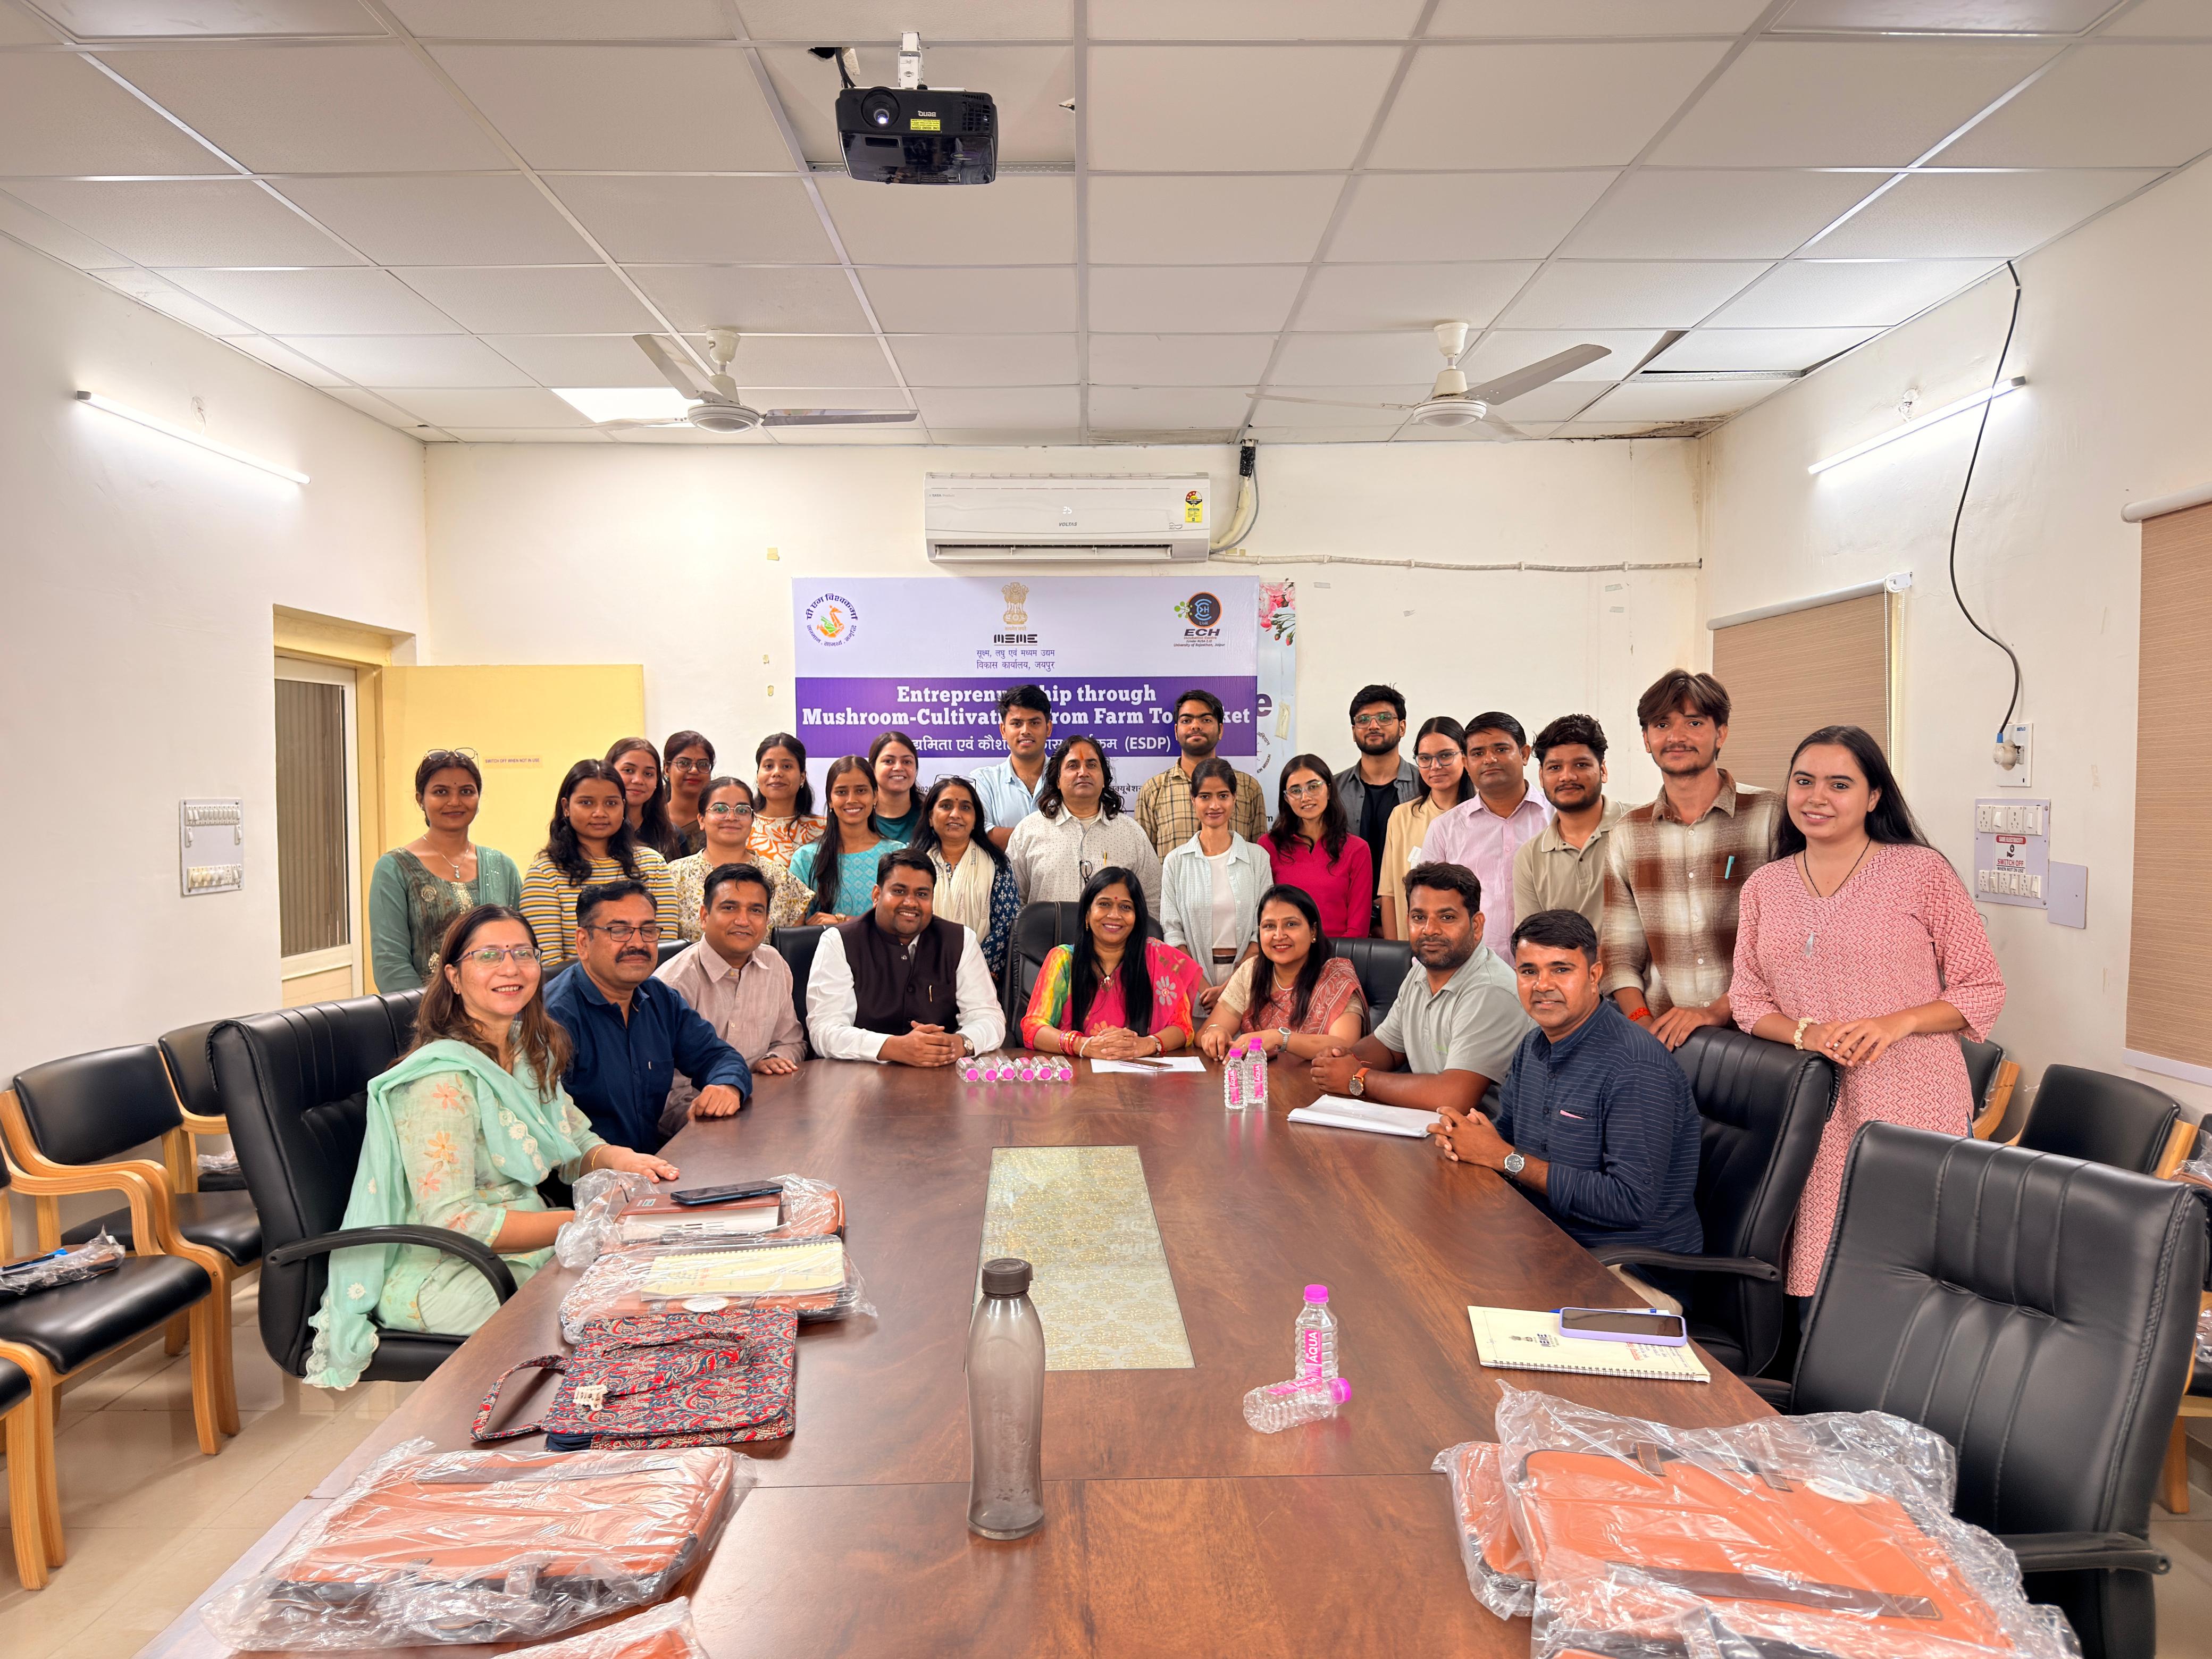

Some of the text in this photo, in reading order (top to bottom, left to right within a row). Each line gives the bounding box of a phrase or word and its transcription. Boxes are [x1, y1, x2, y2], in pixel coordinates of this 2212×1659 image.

[810, 596, 824, 609] एम
[994, 634, 1038, 643] MSME
[977, 650, 992, 659] सूक्ष्म,
[995, 650, 1006, 659] लघु
[1008, 649, 1017, 657] एवं
[977, 659, 1055, 672] विकास कार्यालय, जयपुर
[1077, 685, 1156, 706] through
[802, 706, 1250, 725] Mushroom-Cultivat rom Farm To ket
[956, 735, 974, 751] एवं
[1125, 736, 1171, 753] (ESDP)
[1309, 1332, 1318, 1363] AQUA
